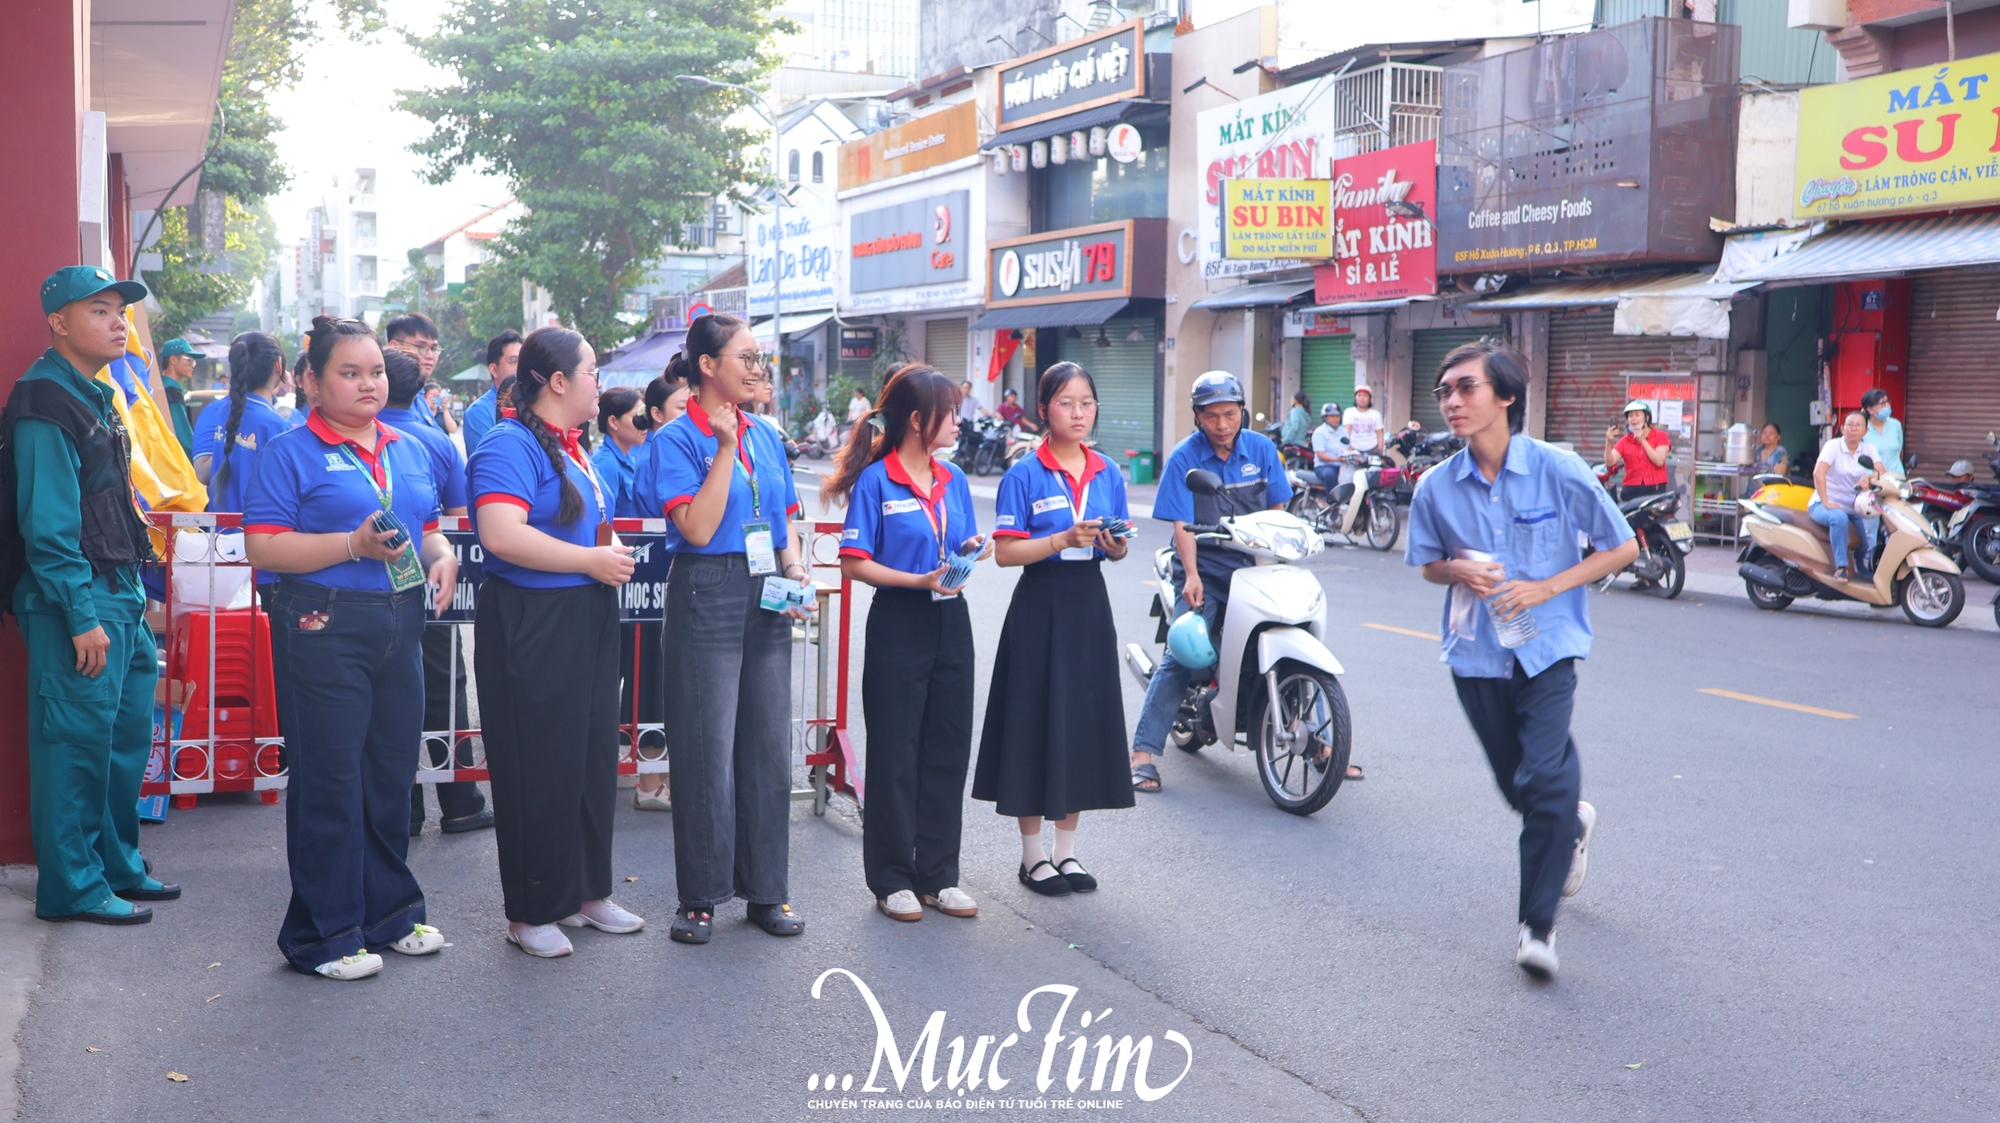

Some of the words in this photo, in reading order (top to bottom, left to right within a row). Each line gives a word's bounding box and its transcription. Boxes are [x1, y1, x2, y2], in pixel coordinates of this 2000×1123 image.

[1032, 59, 1069, 100] NHẬT
[1068, 47, 1097, 89] GIÁ
[1096, 41, 1130, 83] VIỆT
[1886, 67, 1989, 113] MẮT
[1219, 108, 1255, 146] MẮT
[1839, 112, 1963, 171] SU
[1242, 183, 1274, 202] MẮT
[1278, 186, 1315, 202] KÍNH
[1801, 177, 1857, 206] Chuyên
[1865, 174, 1891, 192] LÀM
[1894, 170, 1937, 189] TRÒNG
[1940, 165, 1972, 186] CẬN,
[1975, 156, 2000, 179] VIỄ
[1233, 205, 1269, 228] SU
[1276, 205, 1325, 227] BIN
[1468, 210, 1501, 229] Coffee
[1502, 205, 1520, 226] and
[1521, 203, 1559, 224] Cheesy
[1560, 197, 1592, 219] Foods
[1816, 202, 1827, 213] 67
[1829, 200, 1840, 211] hồ
[1843, 197, 1865, 210] xuân
[1867, 193, 1896, 209] hương
[1899, 193, 1914, 206] p.6
[1922, 190, 1938, 205] q.3
[1335, 218, 1362, 259] ẮT
[1368, 216, 1433, 255] KÍNH
[1454, 250, 1469, 262] 65F
[1563, 237, 1598, 252] TP.HCM
[779, 249, 797, 280] Da
[798, 244, 832, 282] Đẹp
[931, 249, 954, 269] Care
[1082, 241, 1116, 283] 79
[1205, 260, 1223, 277] 65F
[1345, 257, 1361, 285] SỈ
[1364, 262, 1378, 284] &
[1381, 252, 1401, 282] LẺ
[1865, 294, 1877, 303] 67
[842, 348, 855, 357] DA
[625, 581, 650, 615] HỌC
